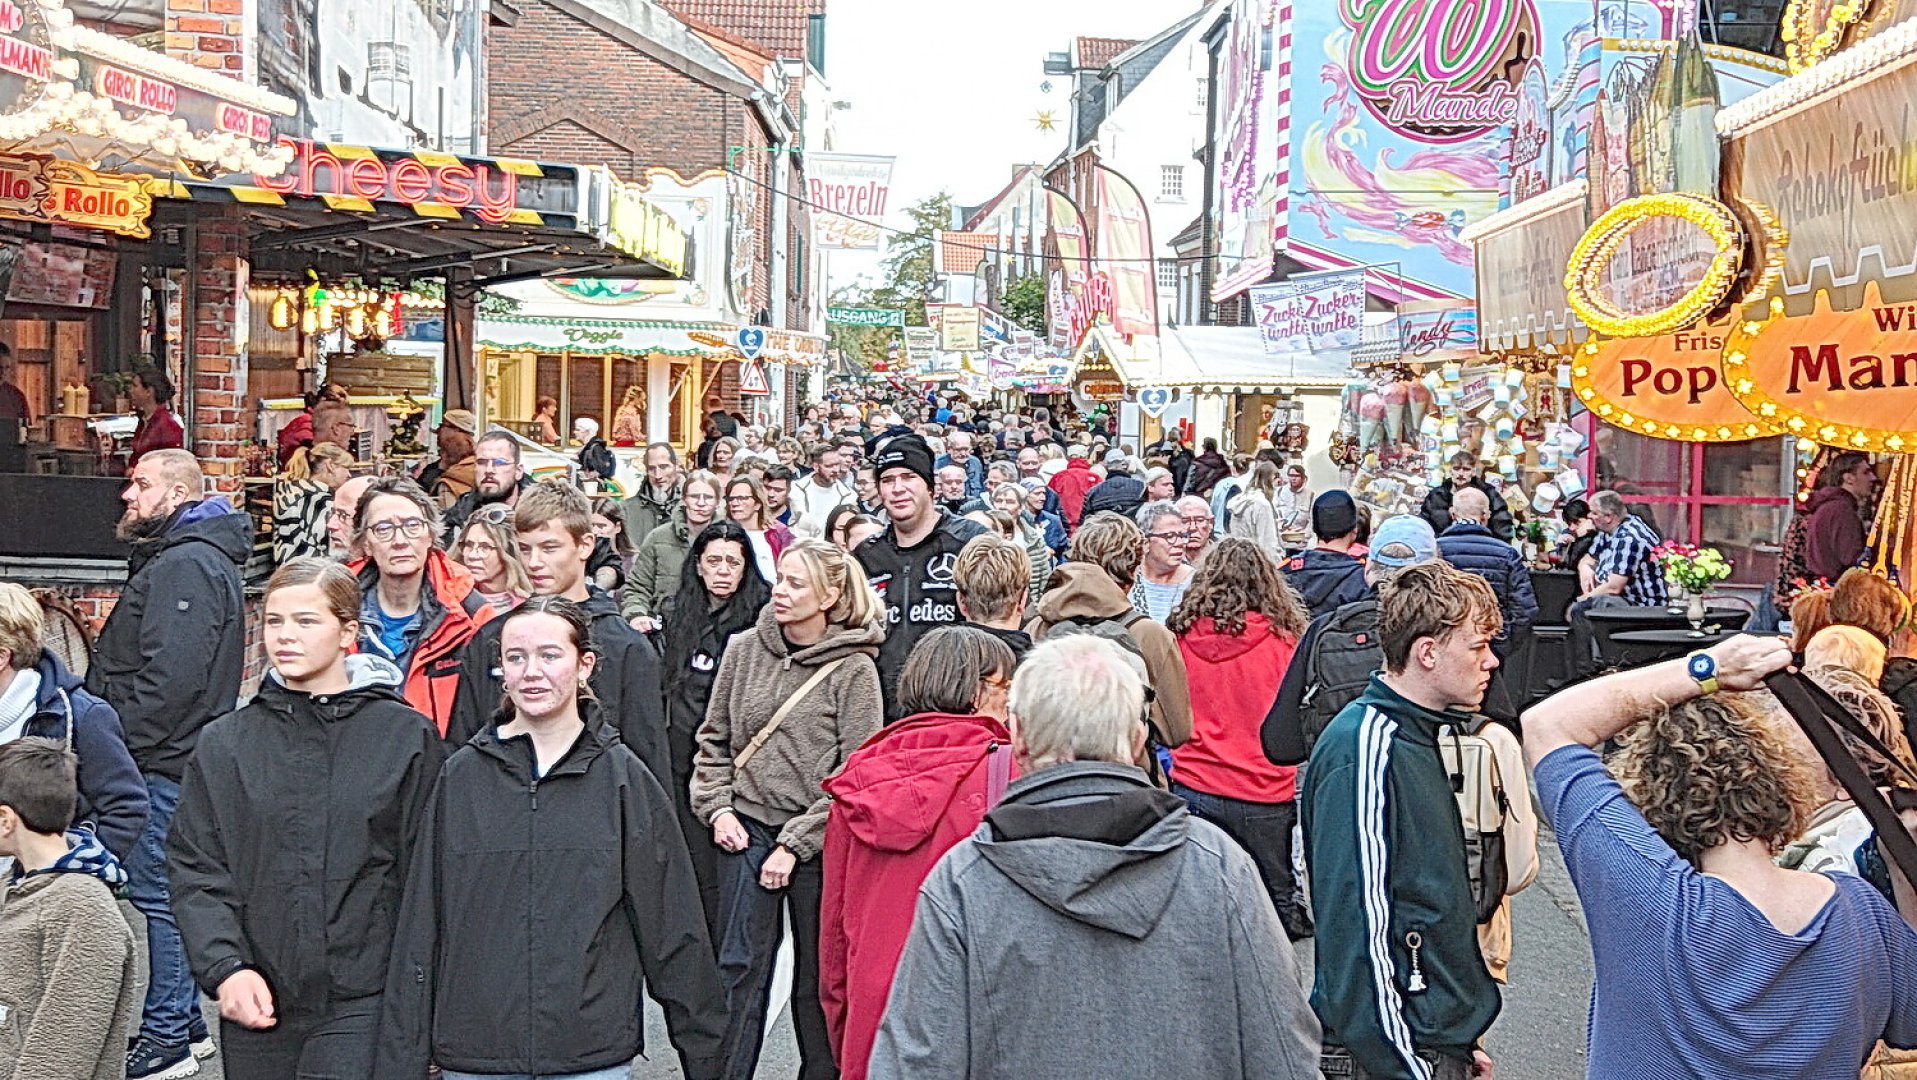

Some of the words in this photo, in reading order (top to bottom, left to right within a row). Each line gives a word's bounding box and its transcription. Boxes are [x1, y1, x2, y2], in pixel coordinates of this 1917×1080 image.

[140, 79, 177, 112] ROLLO
[1390, 83, 1518, 122] Mande
[0, 169, 31, 200] llo
[808, 178, 889, 216] Brezeln
[64, 187, 130, 217] Rollo
[1311, 311, 1357, 337] watte
[1872, 306, 1917, 332] Wi
[1673, 332, 1724, 352] Fris
[1620, 359, 1718, 404] Pop
[1785, 343, 1917, 394] Man
